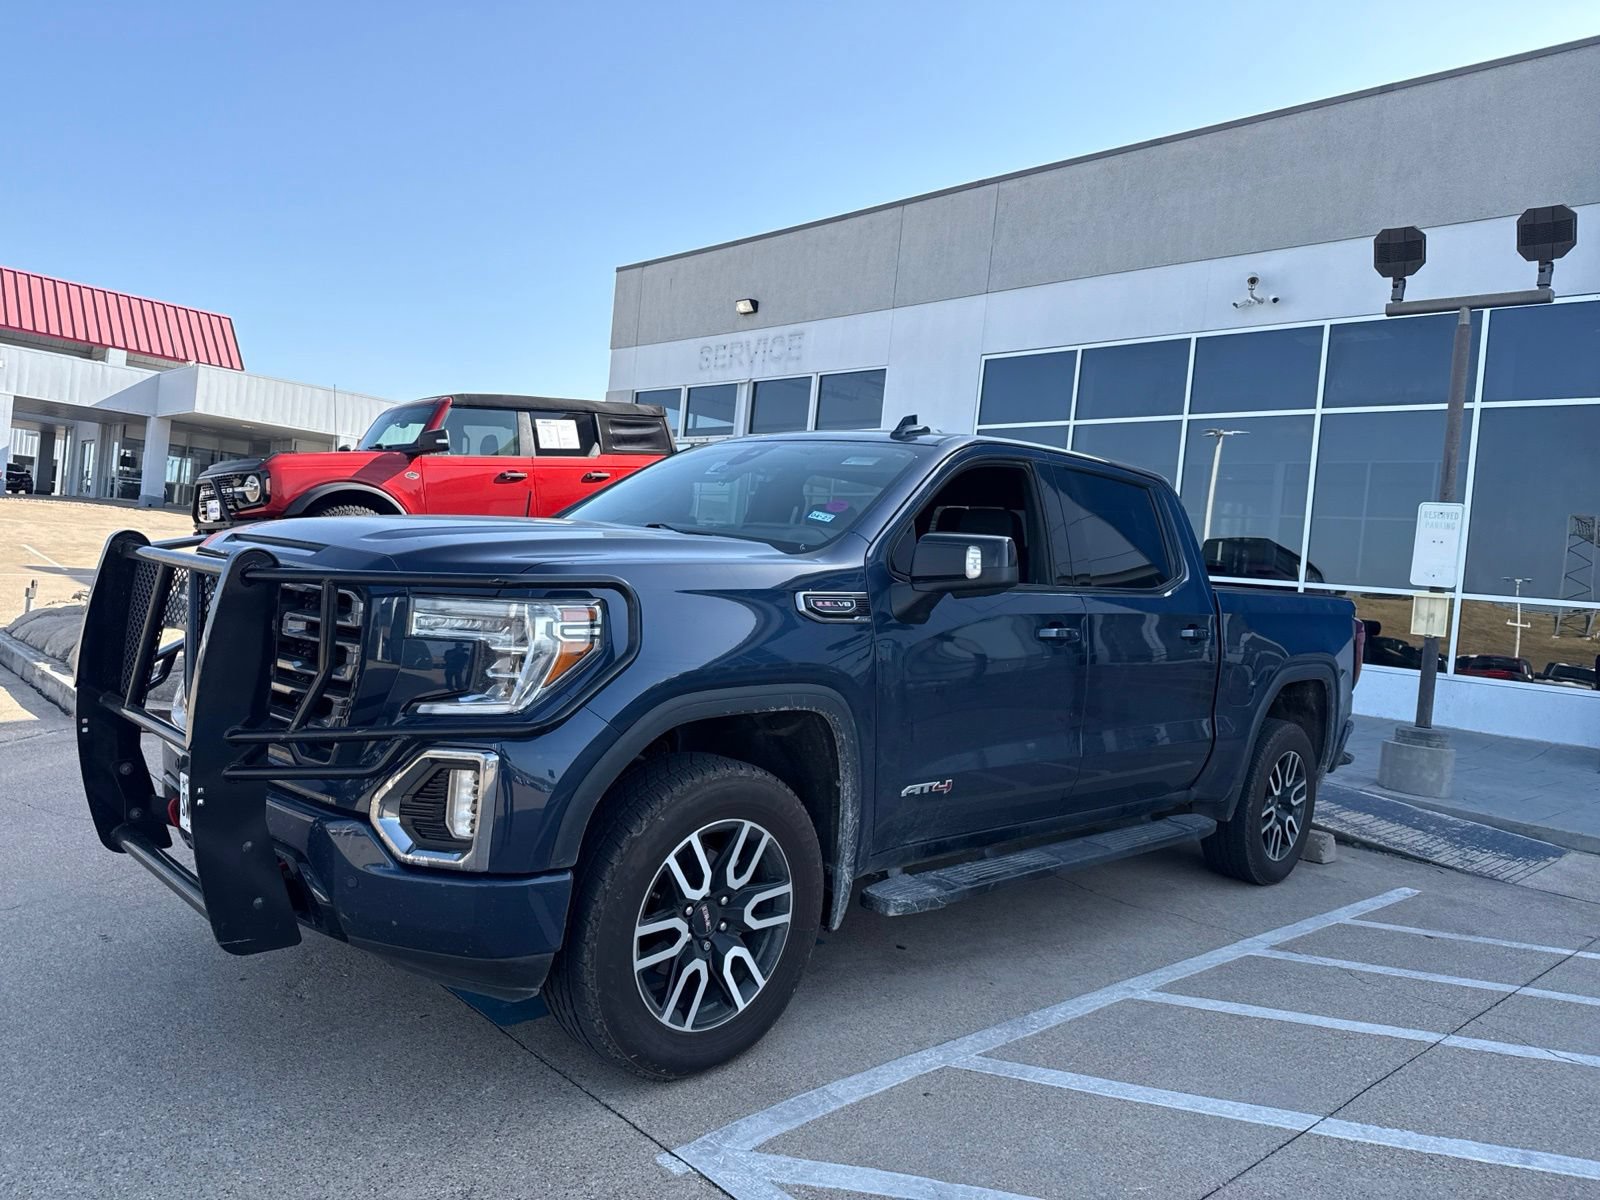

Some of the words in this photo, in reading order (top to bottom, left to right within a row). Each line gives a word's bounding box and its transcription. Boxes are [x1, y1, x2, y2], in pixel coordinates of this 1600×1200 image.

[698, 333, 805, 371] SERVICE
[1423, 511, 1460, 520] RESERVED
[1424, 520, 1457, 530] PARKING
[900, 779, 953, 797] AT4
